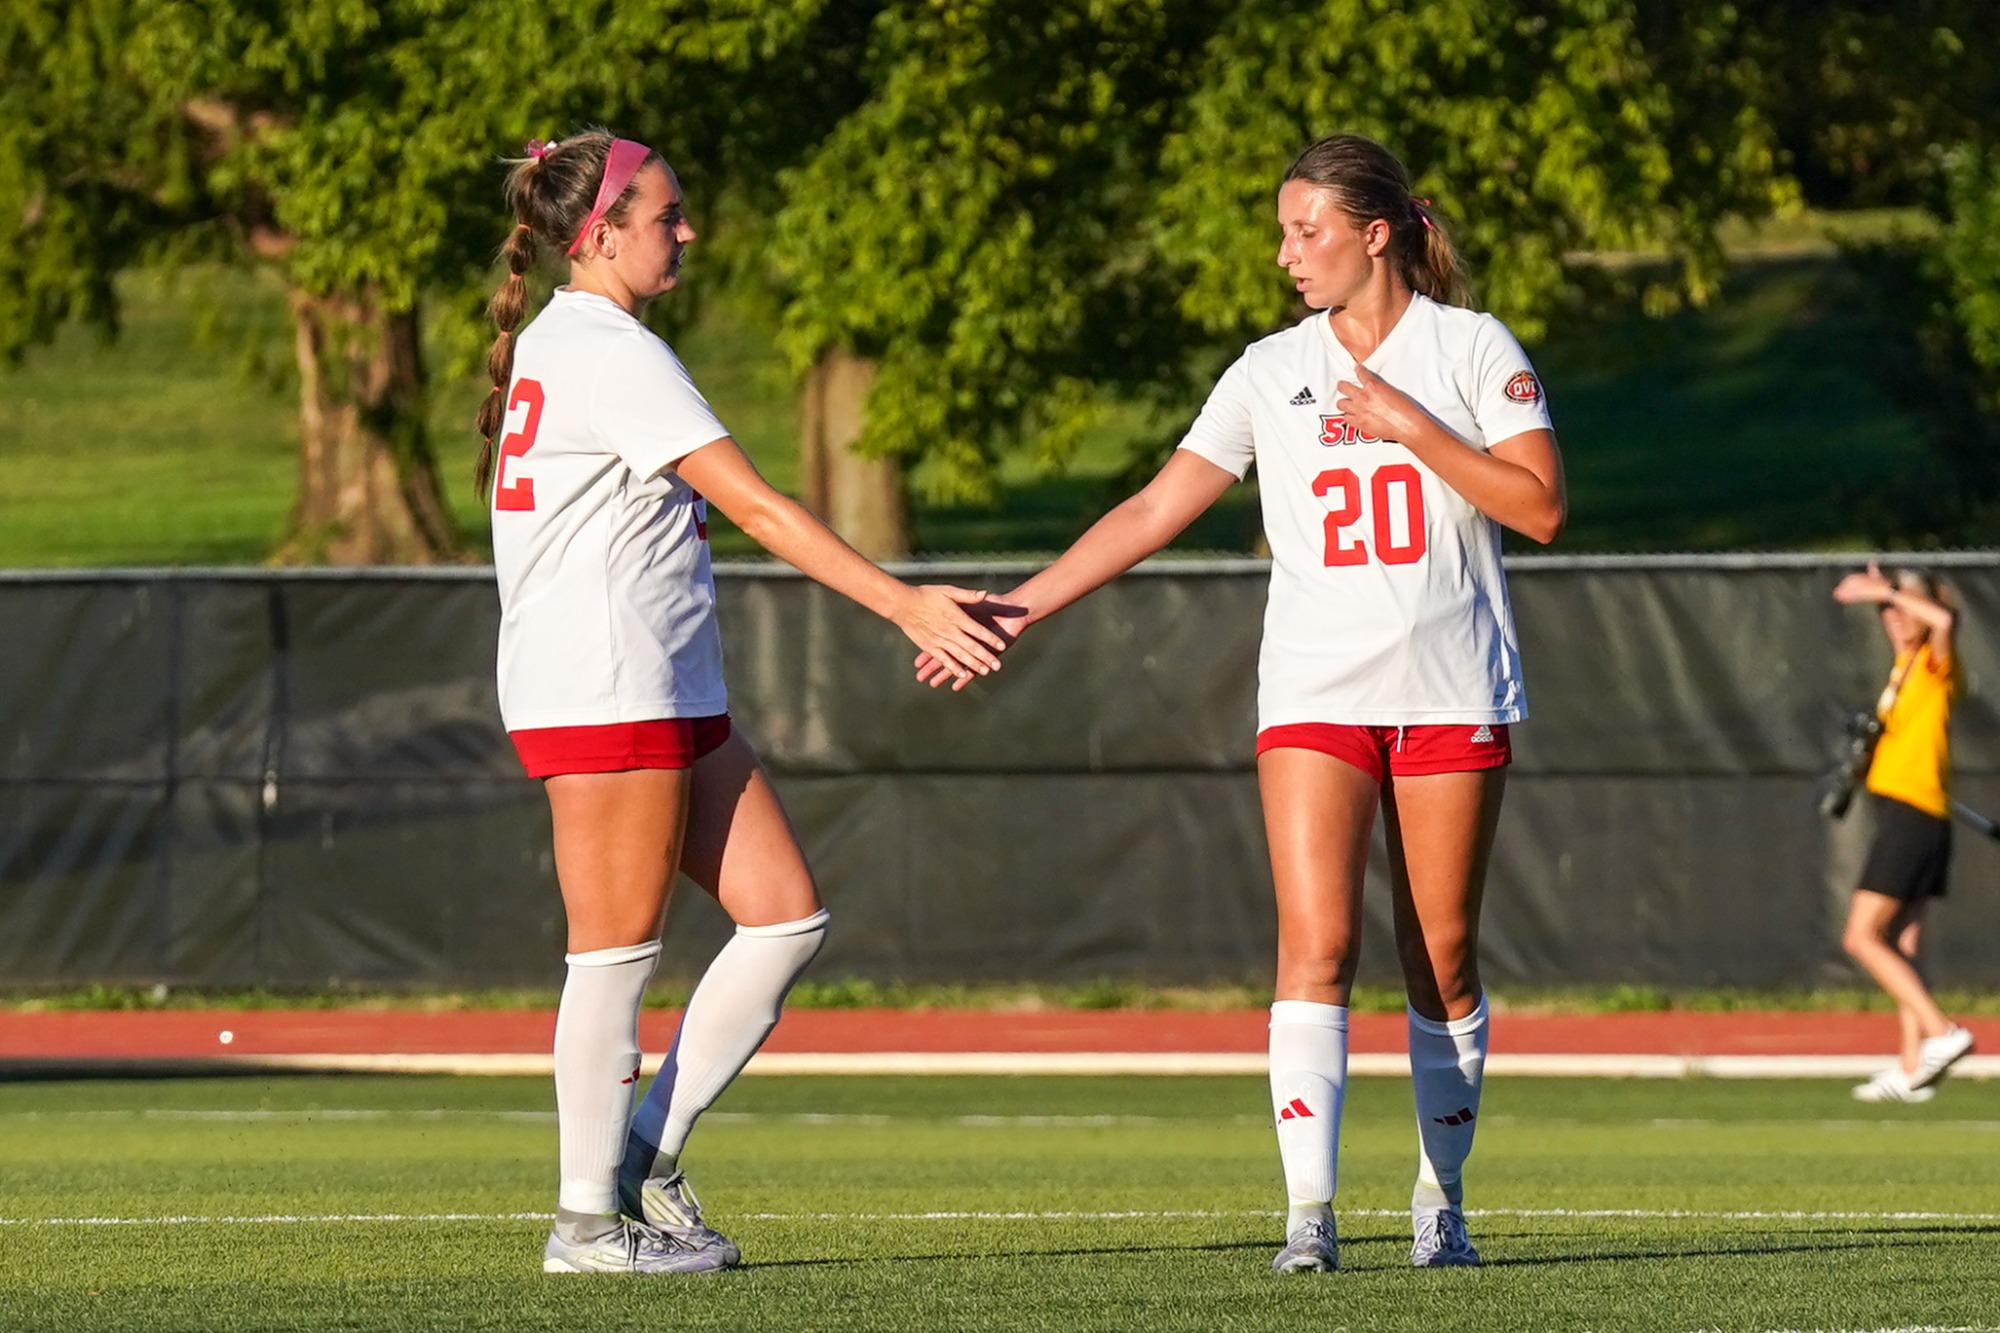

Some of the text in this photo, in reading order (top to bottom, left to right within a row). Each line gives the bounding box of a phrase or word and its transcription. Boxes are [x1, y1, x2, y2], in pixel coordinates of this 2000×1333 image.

[496, 377, 546, 511] 2
[1318, 413, 1399, 447] SI
[1311, 463, 1427, 567] 20
